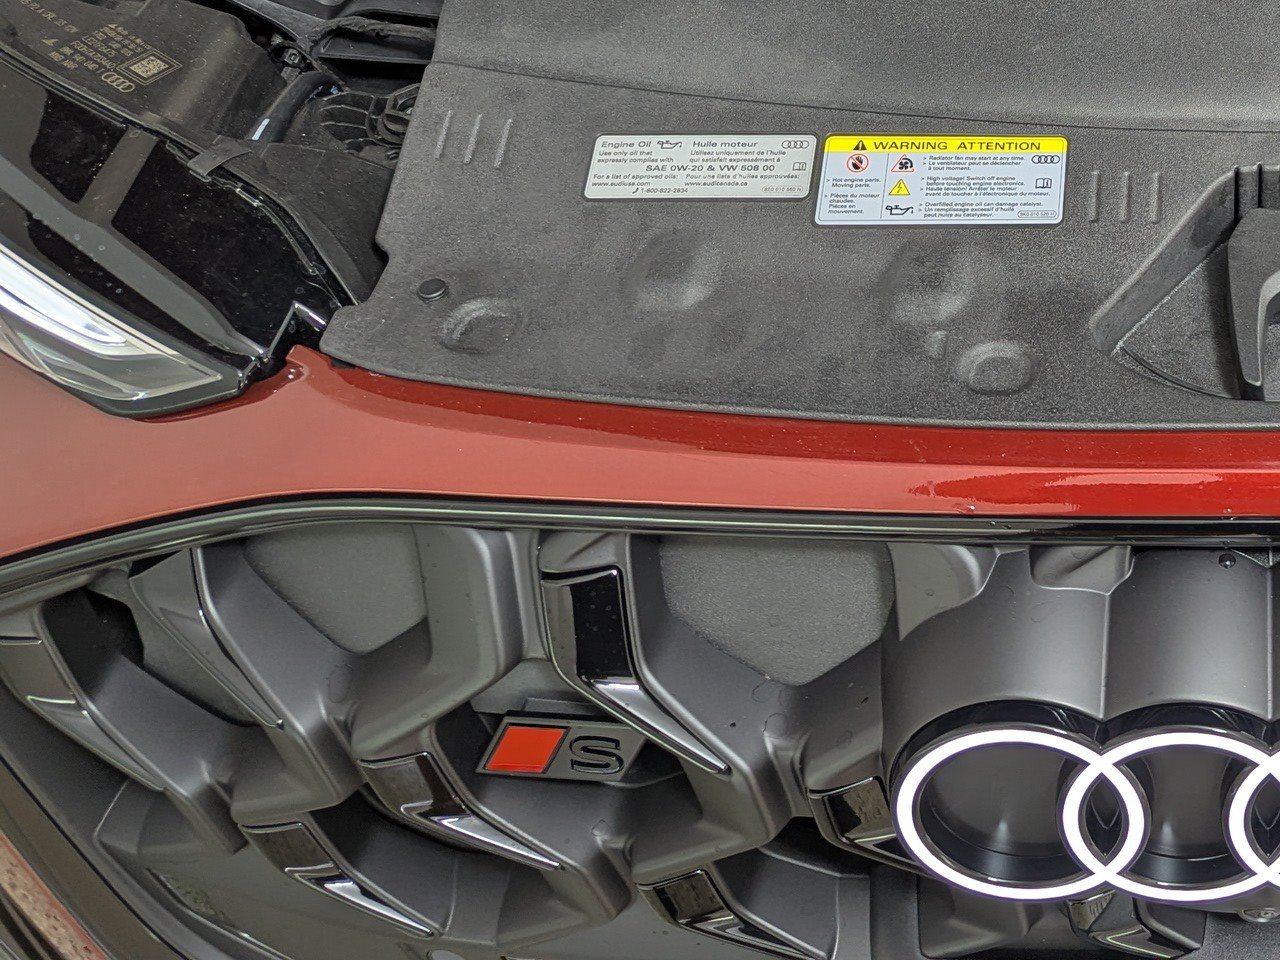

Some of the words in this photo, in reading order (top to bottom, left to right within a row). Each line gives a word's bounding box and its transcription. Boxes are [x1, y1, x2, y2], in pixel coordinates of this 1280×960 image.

[601, 141, 634, 149] Engine
[874, 142, 948, 150] WARNING
[957, 142, 1040, 150] ATTENTION
[569, 735, 624, 774] S
